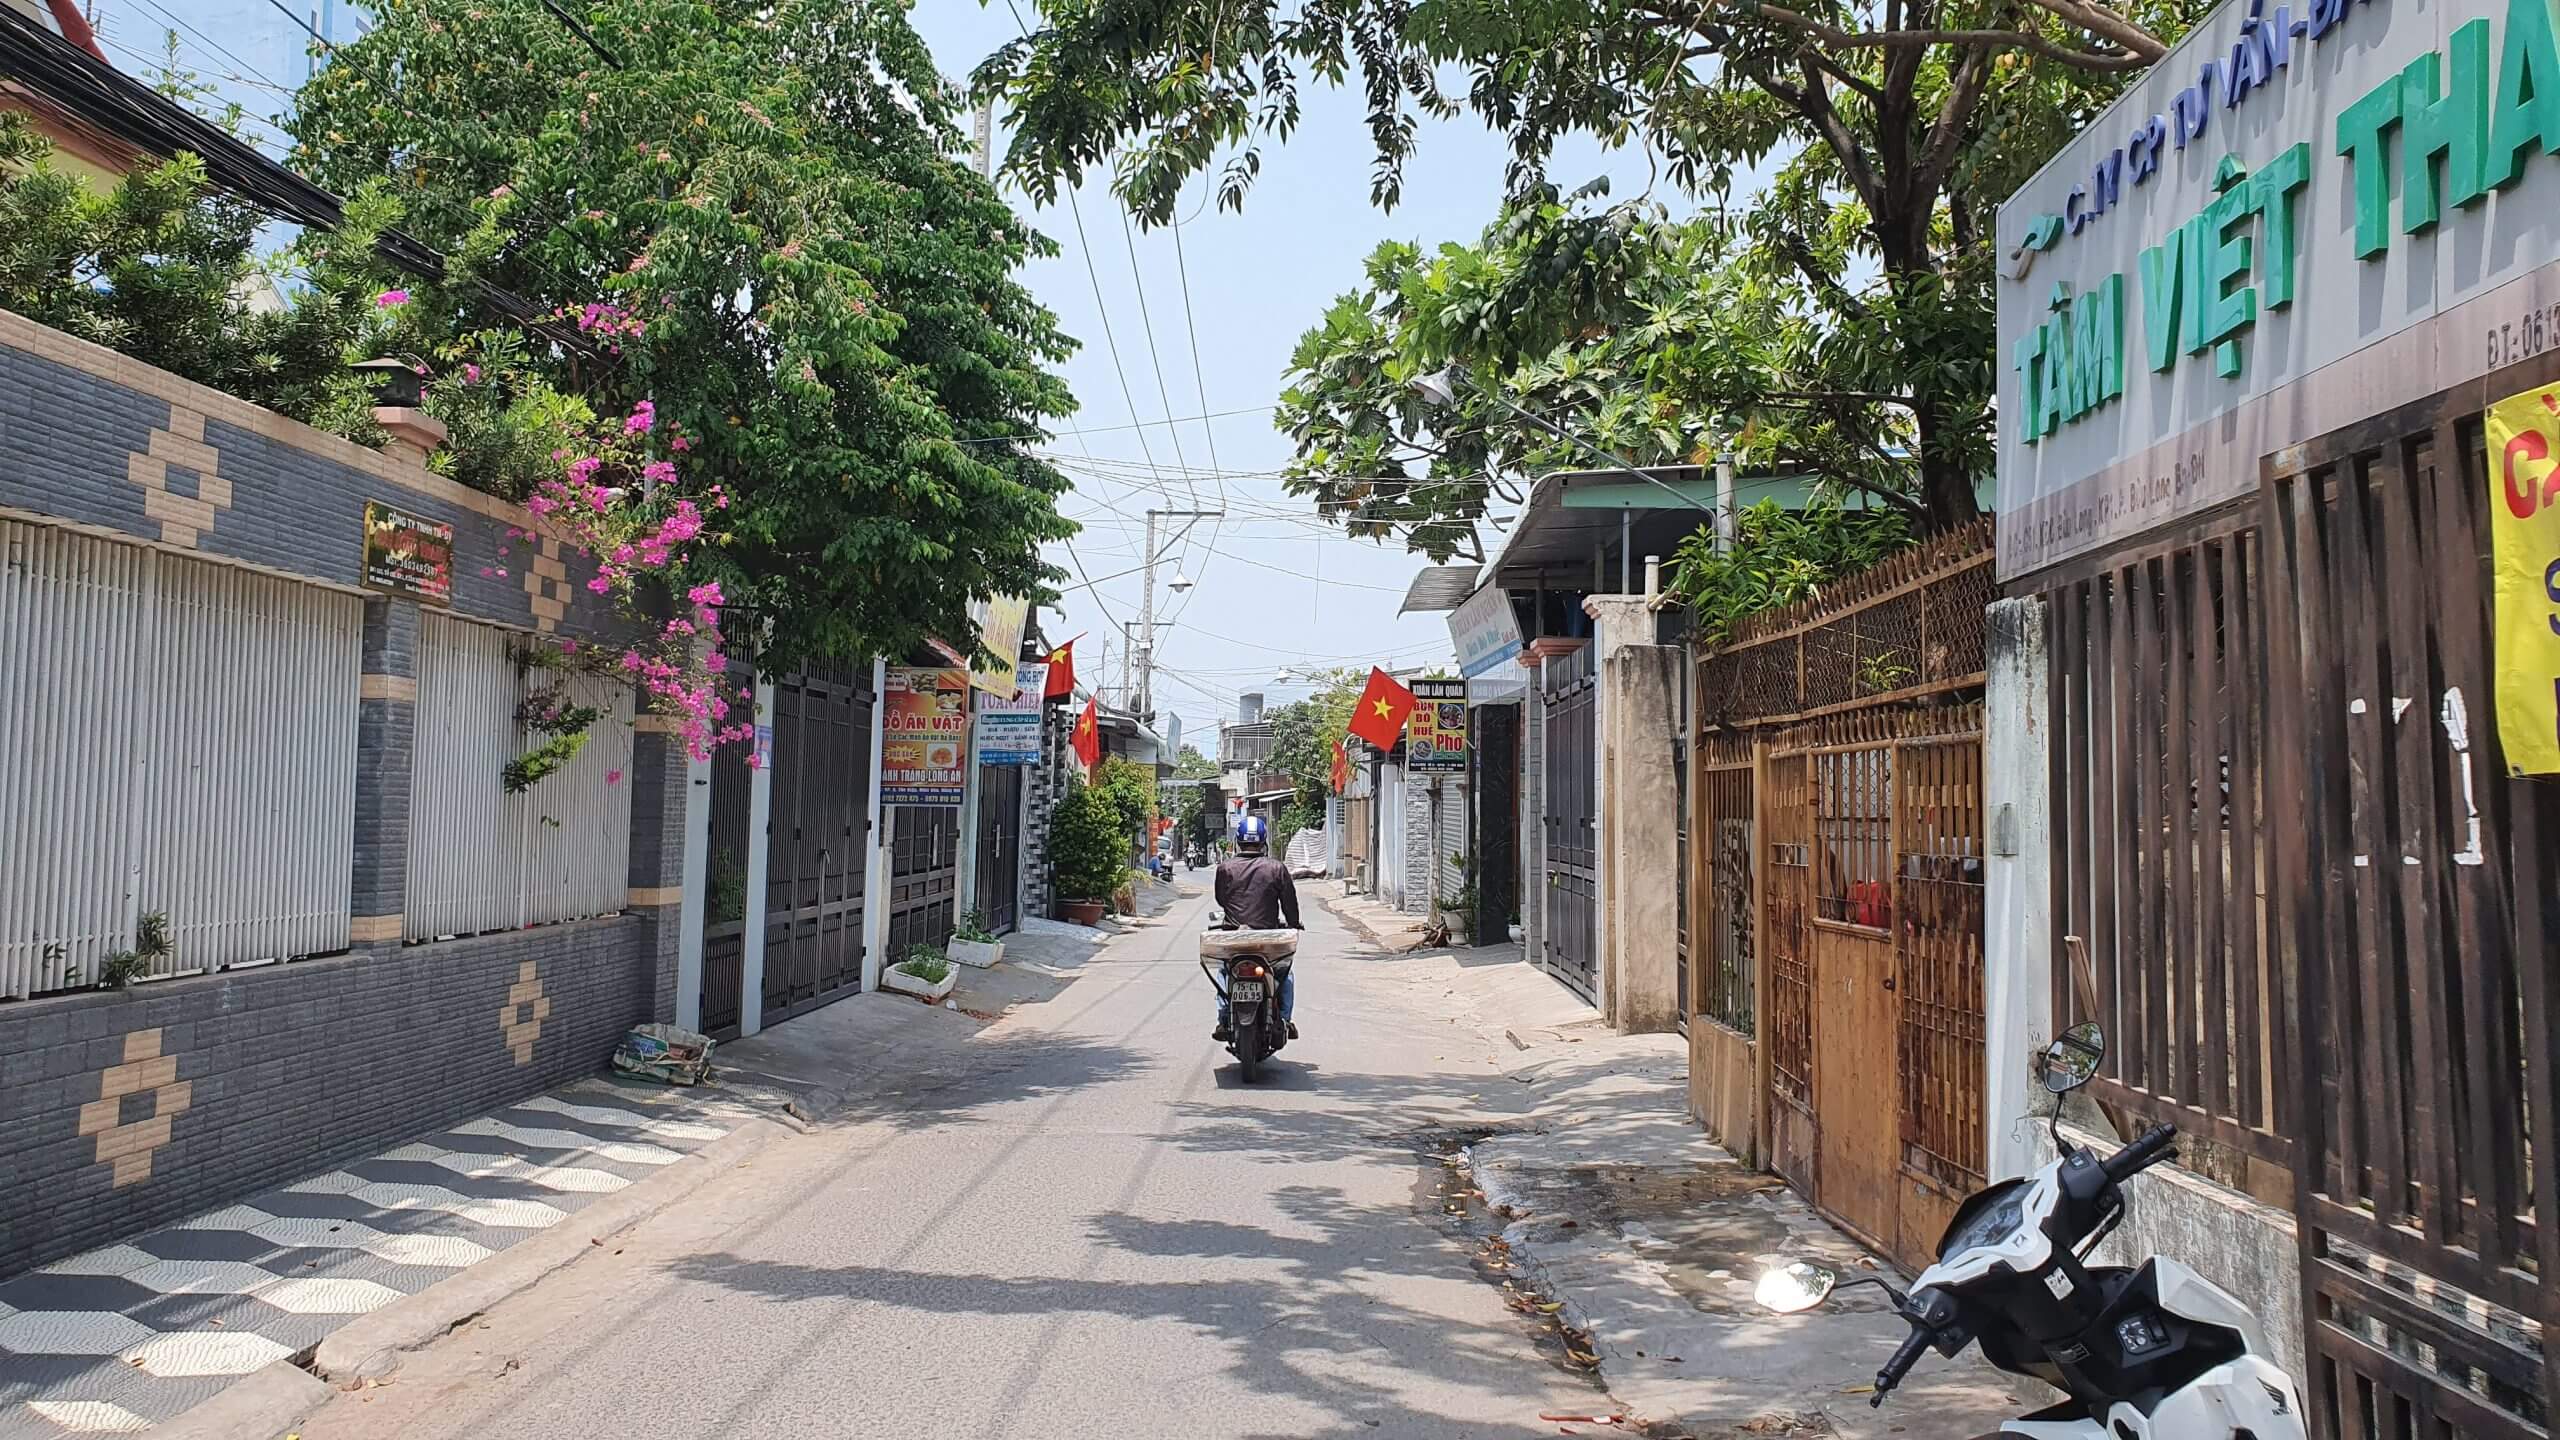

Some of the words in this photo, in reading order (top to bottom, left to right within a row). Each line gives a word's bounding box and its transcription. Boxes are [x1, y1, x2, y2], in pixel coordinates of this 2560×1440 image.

[2014, 272, 2123, 446] TÂM
[2138, 141, 2310, 379] VIỆT
[1436, 733, 1462, 752] Phở
